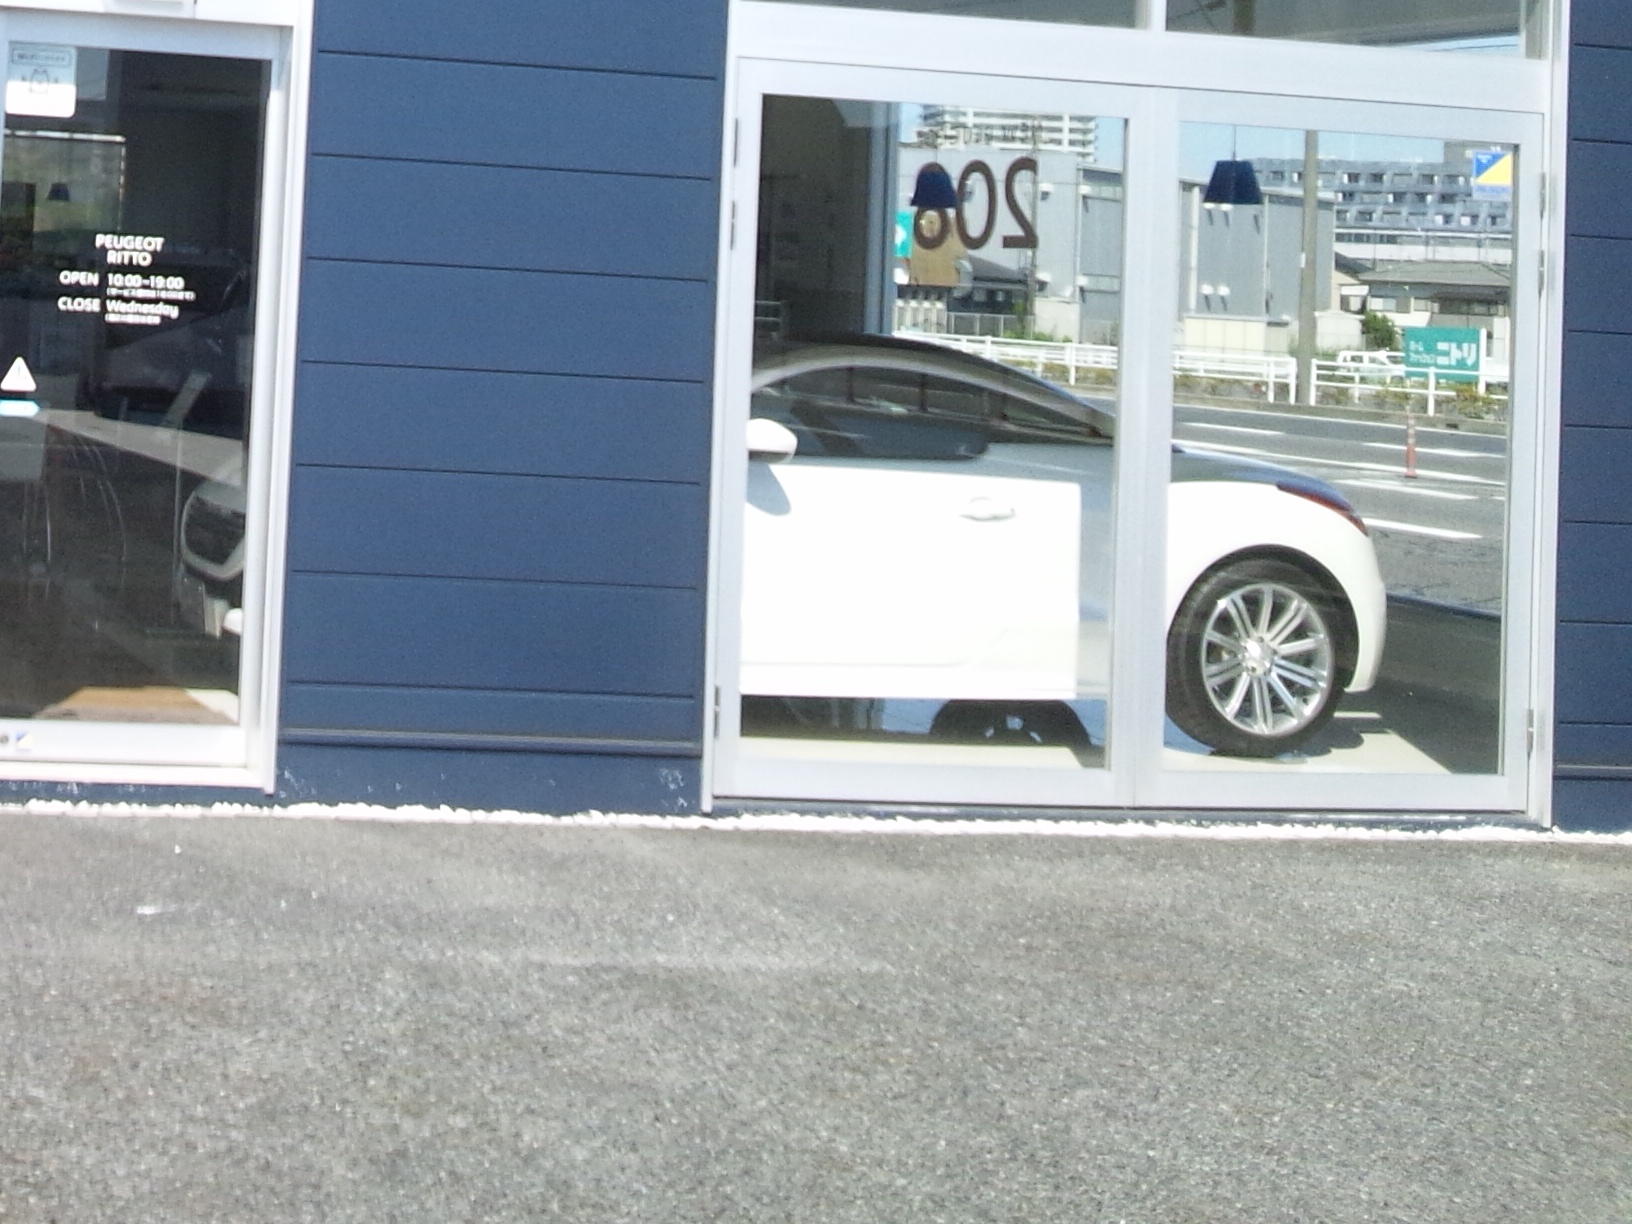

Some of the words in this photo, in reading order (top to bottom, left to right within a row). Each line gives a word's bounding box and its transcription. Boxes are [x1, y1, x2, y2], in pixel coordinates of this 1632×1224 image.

[95, 233, 164, 253] PEUGEOT
[107, 250, 152, 267] RITTO
[59, 270, 99, 287] OPEN
[57, 296, 101, 313] CLOSE
[106, 299, 179, 320] Wednesday
[1436, 341, 1477, 366] ニトリ
